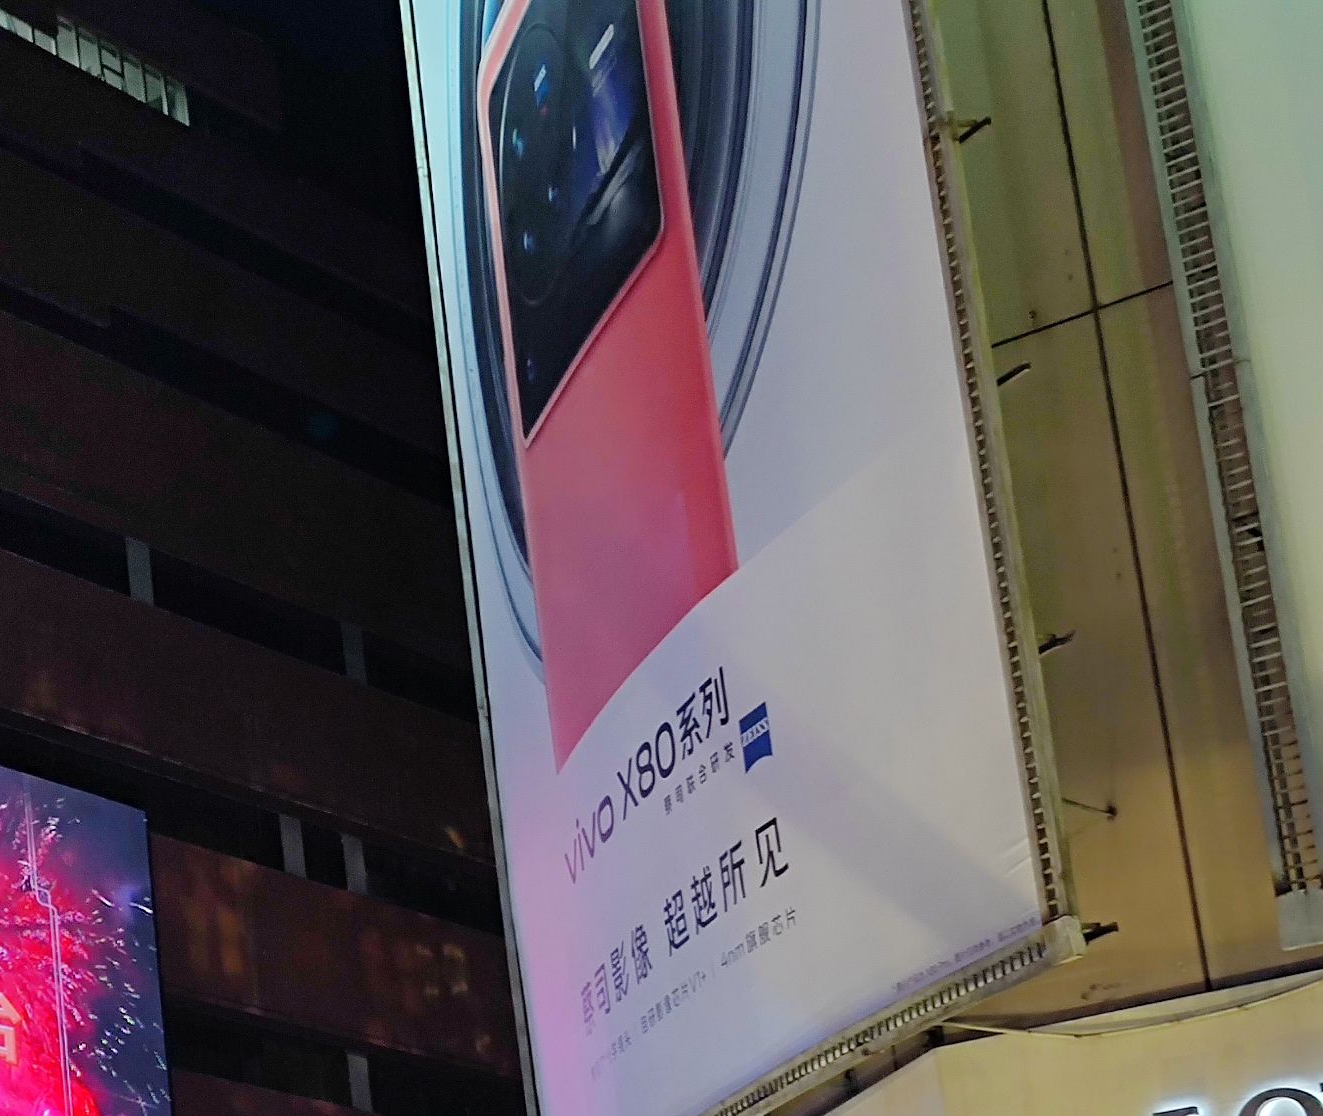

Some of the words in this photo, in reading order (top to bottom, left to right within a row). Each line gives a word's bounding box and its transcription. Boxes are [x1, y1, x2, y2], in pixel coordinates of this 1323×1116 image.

[565, 795, 614, 884] vivo
[617, 666, 730, 821] X80系列
[664, 742, 736, 816] 蔡司联合研发
[663, 817, 789, 957] 超越所见
